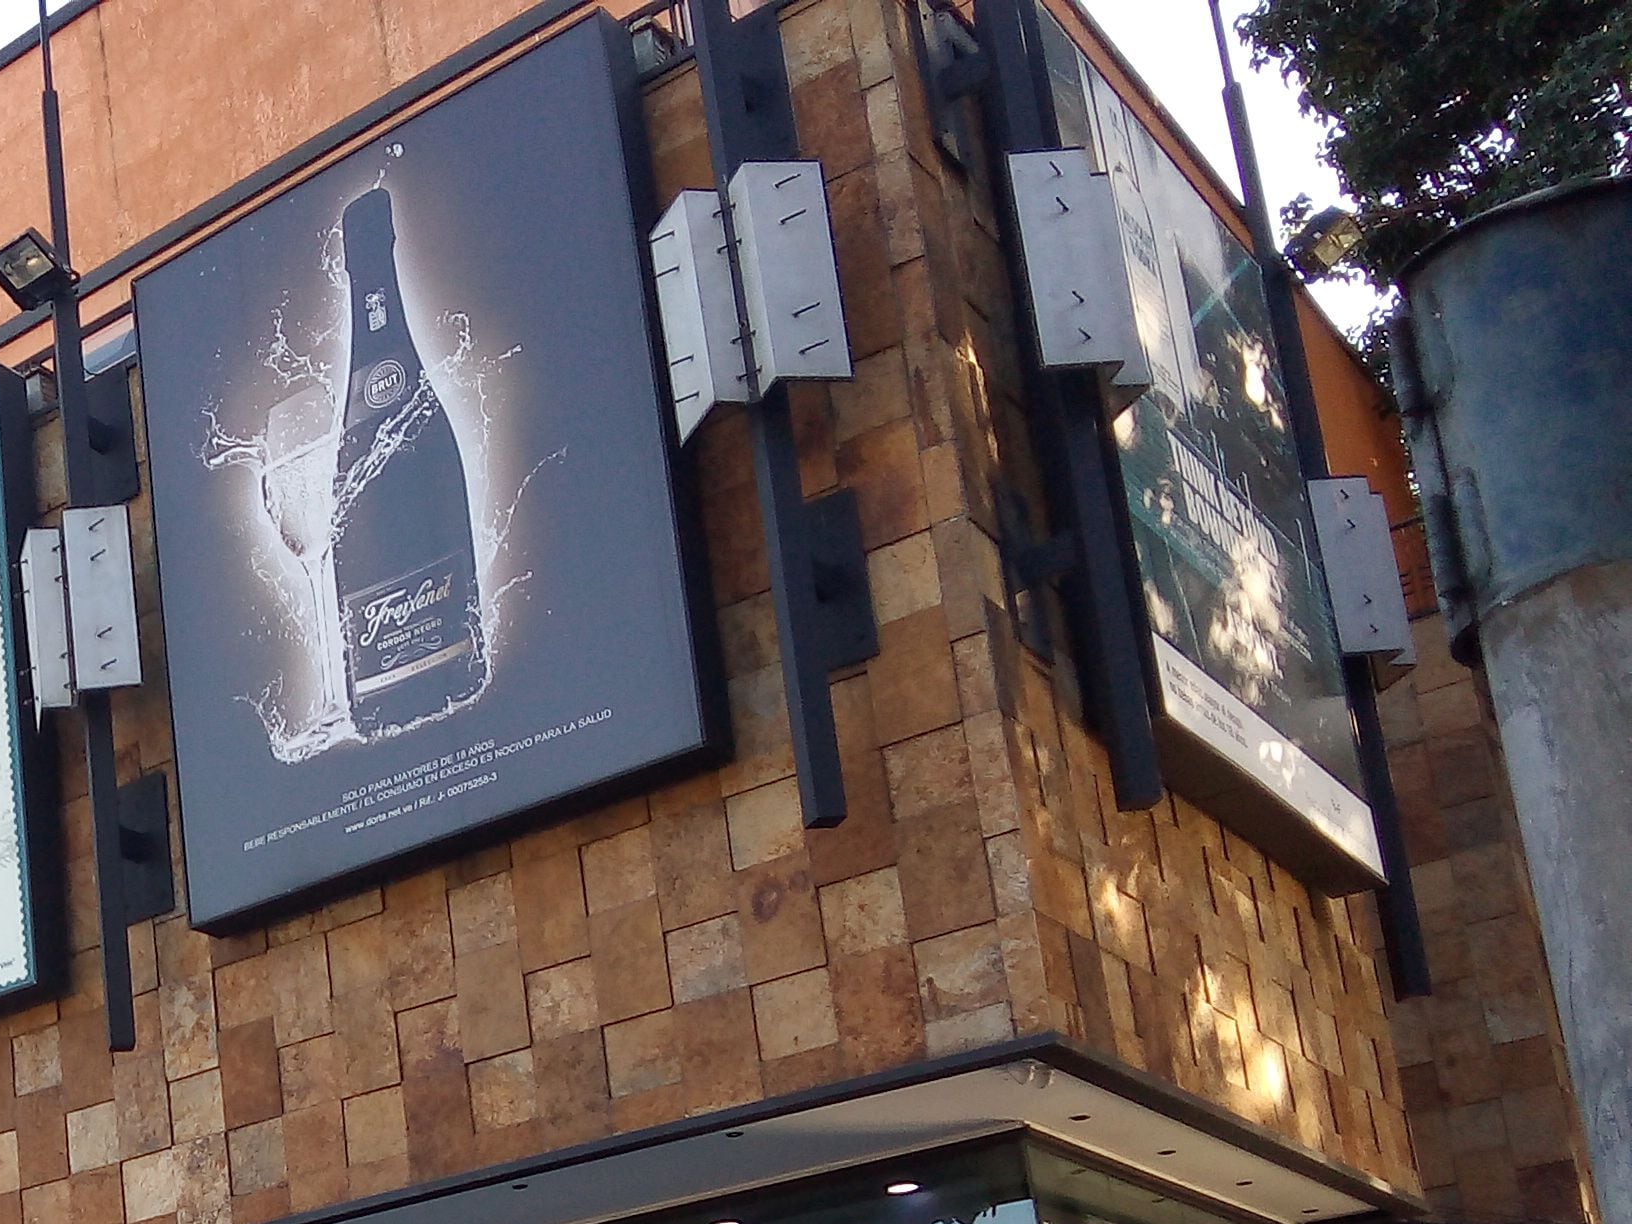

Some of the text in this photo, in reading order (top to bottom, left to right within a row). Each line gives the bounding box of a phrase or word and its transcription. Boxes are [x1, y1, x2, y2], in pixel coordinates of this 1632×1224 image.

[371, 373, 399, 396] BRUT
[1166, 430, 1221, 514] THINK
[359, 572, 453, 647] Freixenet
[377, 629, 412, 651] CORDON
[413, 617, 443, 637] NEGRO
[266, 801, 358, 843] RESPONSABLEMENTE
[363, 796, 377, 808] EL
[376, 777, 424, 802] CONSUMO
[424, 771, 440, 786] EN
[439, 758, 480, 780] EXCESO
[479, 751, 495, 765] ES
[494, 737, 534, 760] NOCIVO
[534, 726, 562, 745] PARA
[562, 720, 577, 735] LA
[577, 707, 613, 730] SALUD
[341, 786, 368, 803] SOLO
[368, 777, 393, 793] PARA
[393, 759, 440, 785] MAYORES
[440, 755, 454, 768] DE
[455, 750, 467, 763] 18
